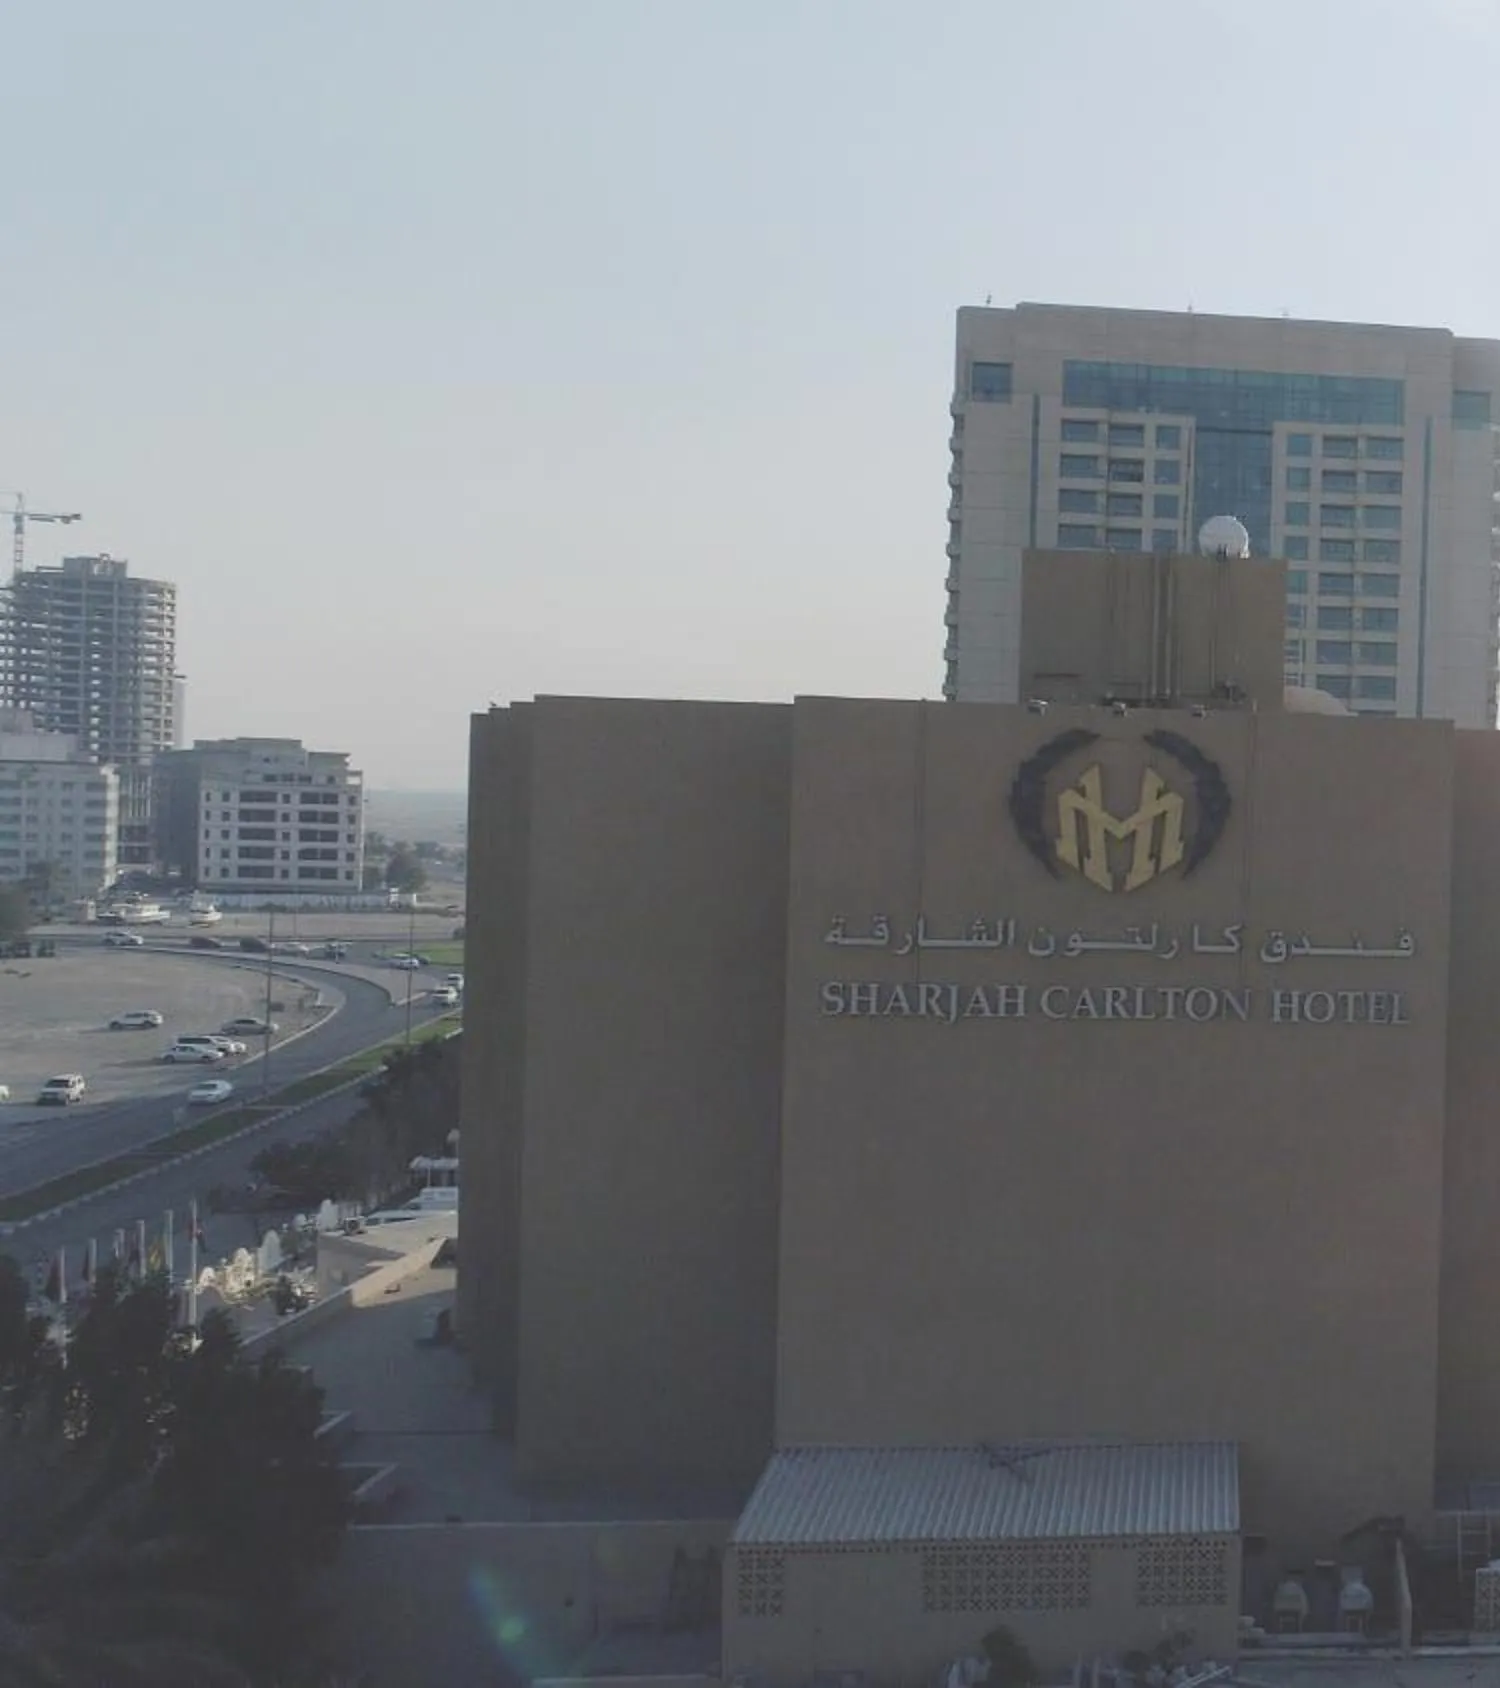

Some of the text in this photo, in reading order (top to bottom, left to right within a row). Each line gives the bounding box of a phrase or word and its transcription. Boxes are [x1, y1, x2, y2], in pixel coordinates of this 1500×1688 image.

[824, 913, 1016, 956] الشارقة
[1260, 927, 1415, 963] فندق
[821, 981, 1410, 1026] SHARJAH CARLTON HOTEL
